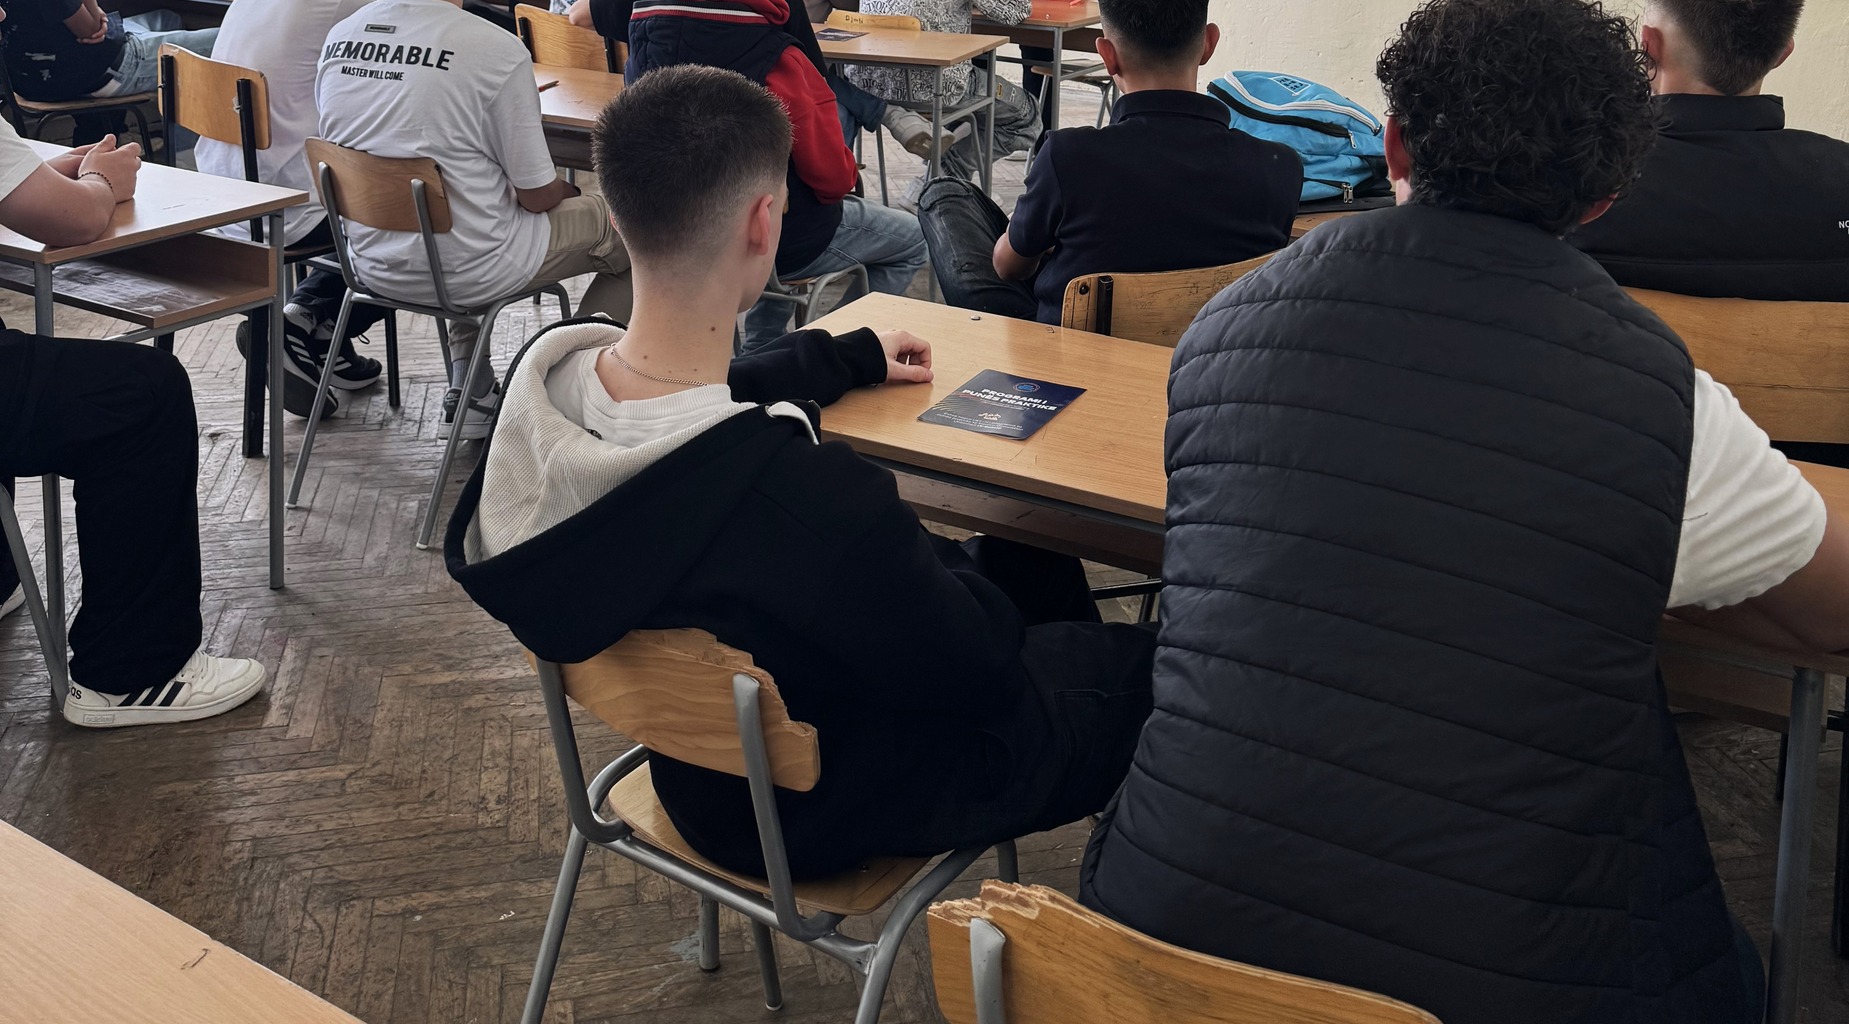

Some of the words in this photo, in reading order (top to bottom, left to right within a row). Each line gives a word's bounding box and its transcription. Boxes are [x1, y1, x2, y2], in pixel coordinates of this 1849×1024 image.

[341, 65, 368, 78] MASTER
[368, 69, 384, 80] WILL
[384, 71, 405, 81] COME
[981, 388, 1042, 404] PROGRAMI
[1000, 398, 1057, 411] PRAKTIKE
